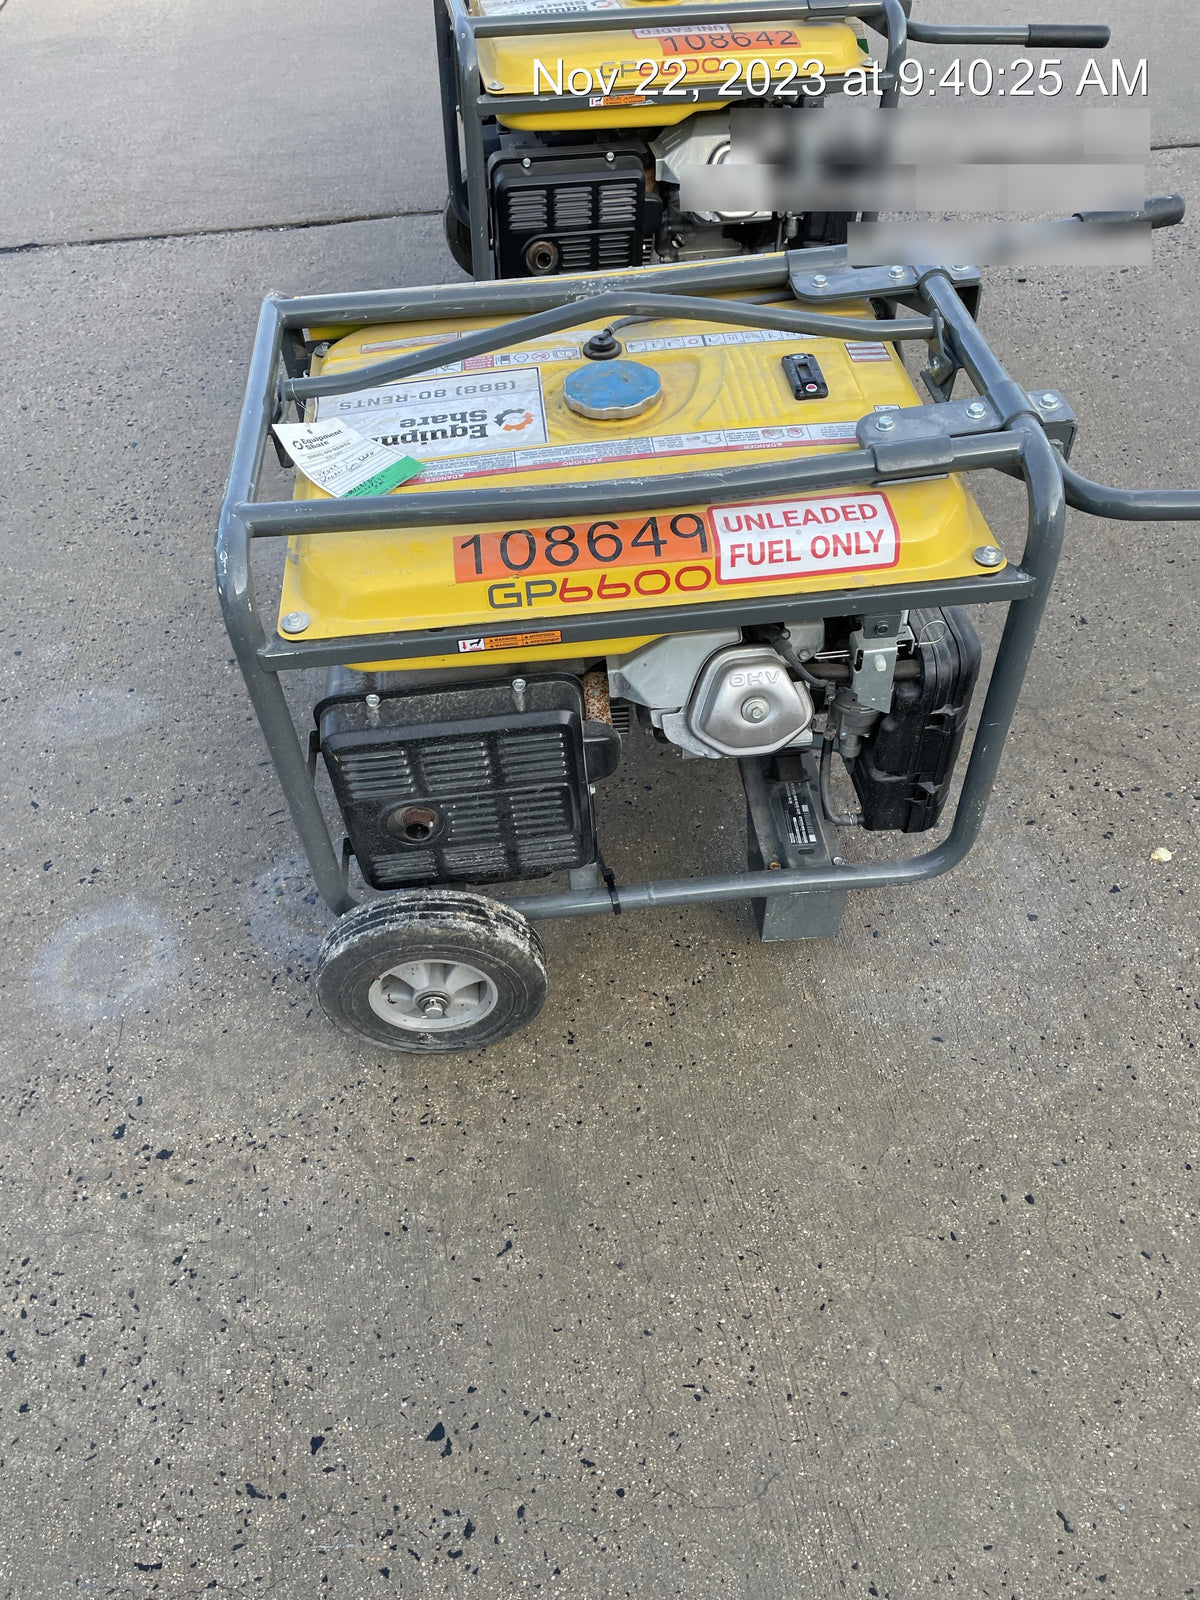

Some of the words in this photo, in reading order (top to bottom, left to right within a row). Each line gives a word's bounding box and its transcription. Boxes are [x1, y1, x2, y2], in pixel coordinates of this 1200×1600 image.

[664, 30, 799, 51] 108642
[455, 380, 516, 395] (888)
[339, 388, 446, 411] 80-RENTS
[400, 409, 488, 429] Share
[301, 428, 344, 447] Equipment
[370, 423, 489, 447] Equipm
[425, 474, 458, 483] DANGER
[723, 503, 879, 533] UNLEADED
[460, 513, 709, 575] 108649
[729, 539, 803, 567] FUEL
[810, 530, 886, 560] ONLY
[489, 565, 711, 609] GP6600
[729, 671, 780, 688] OHV
